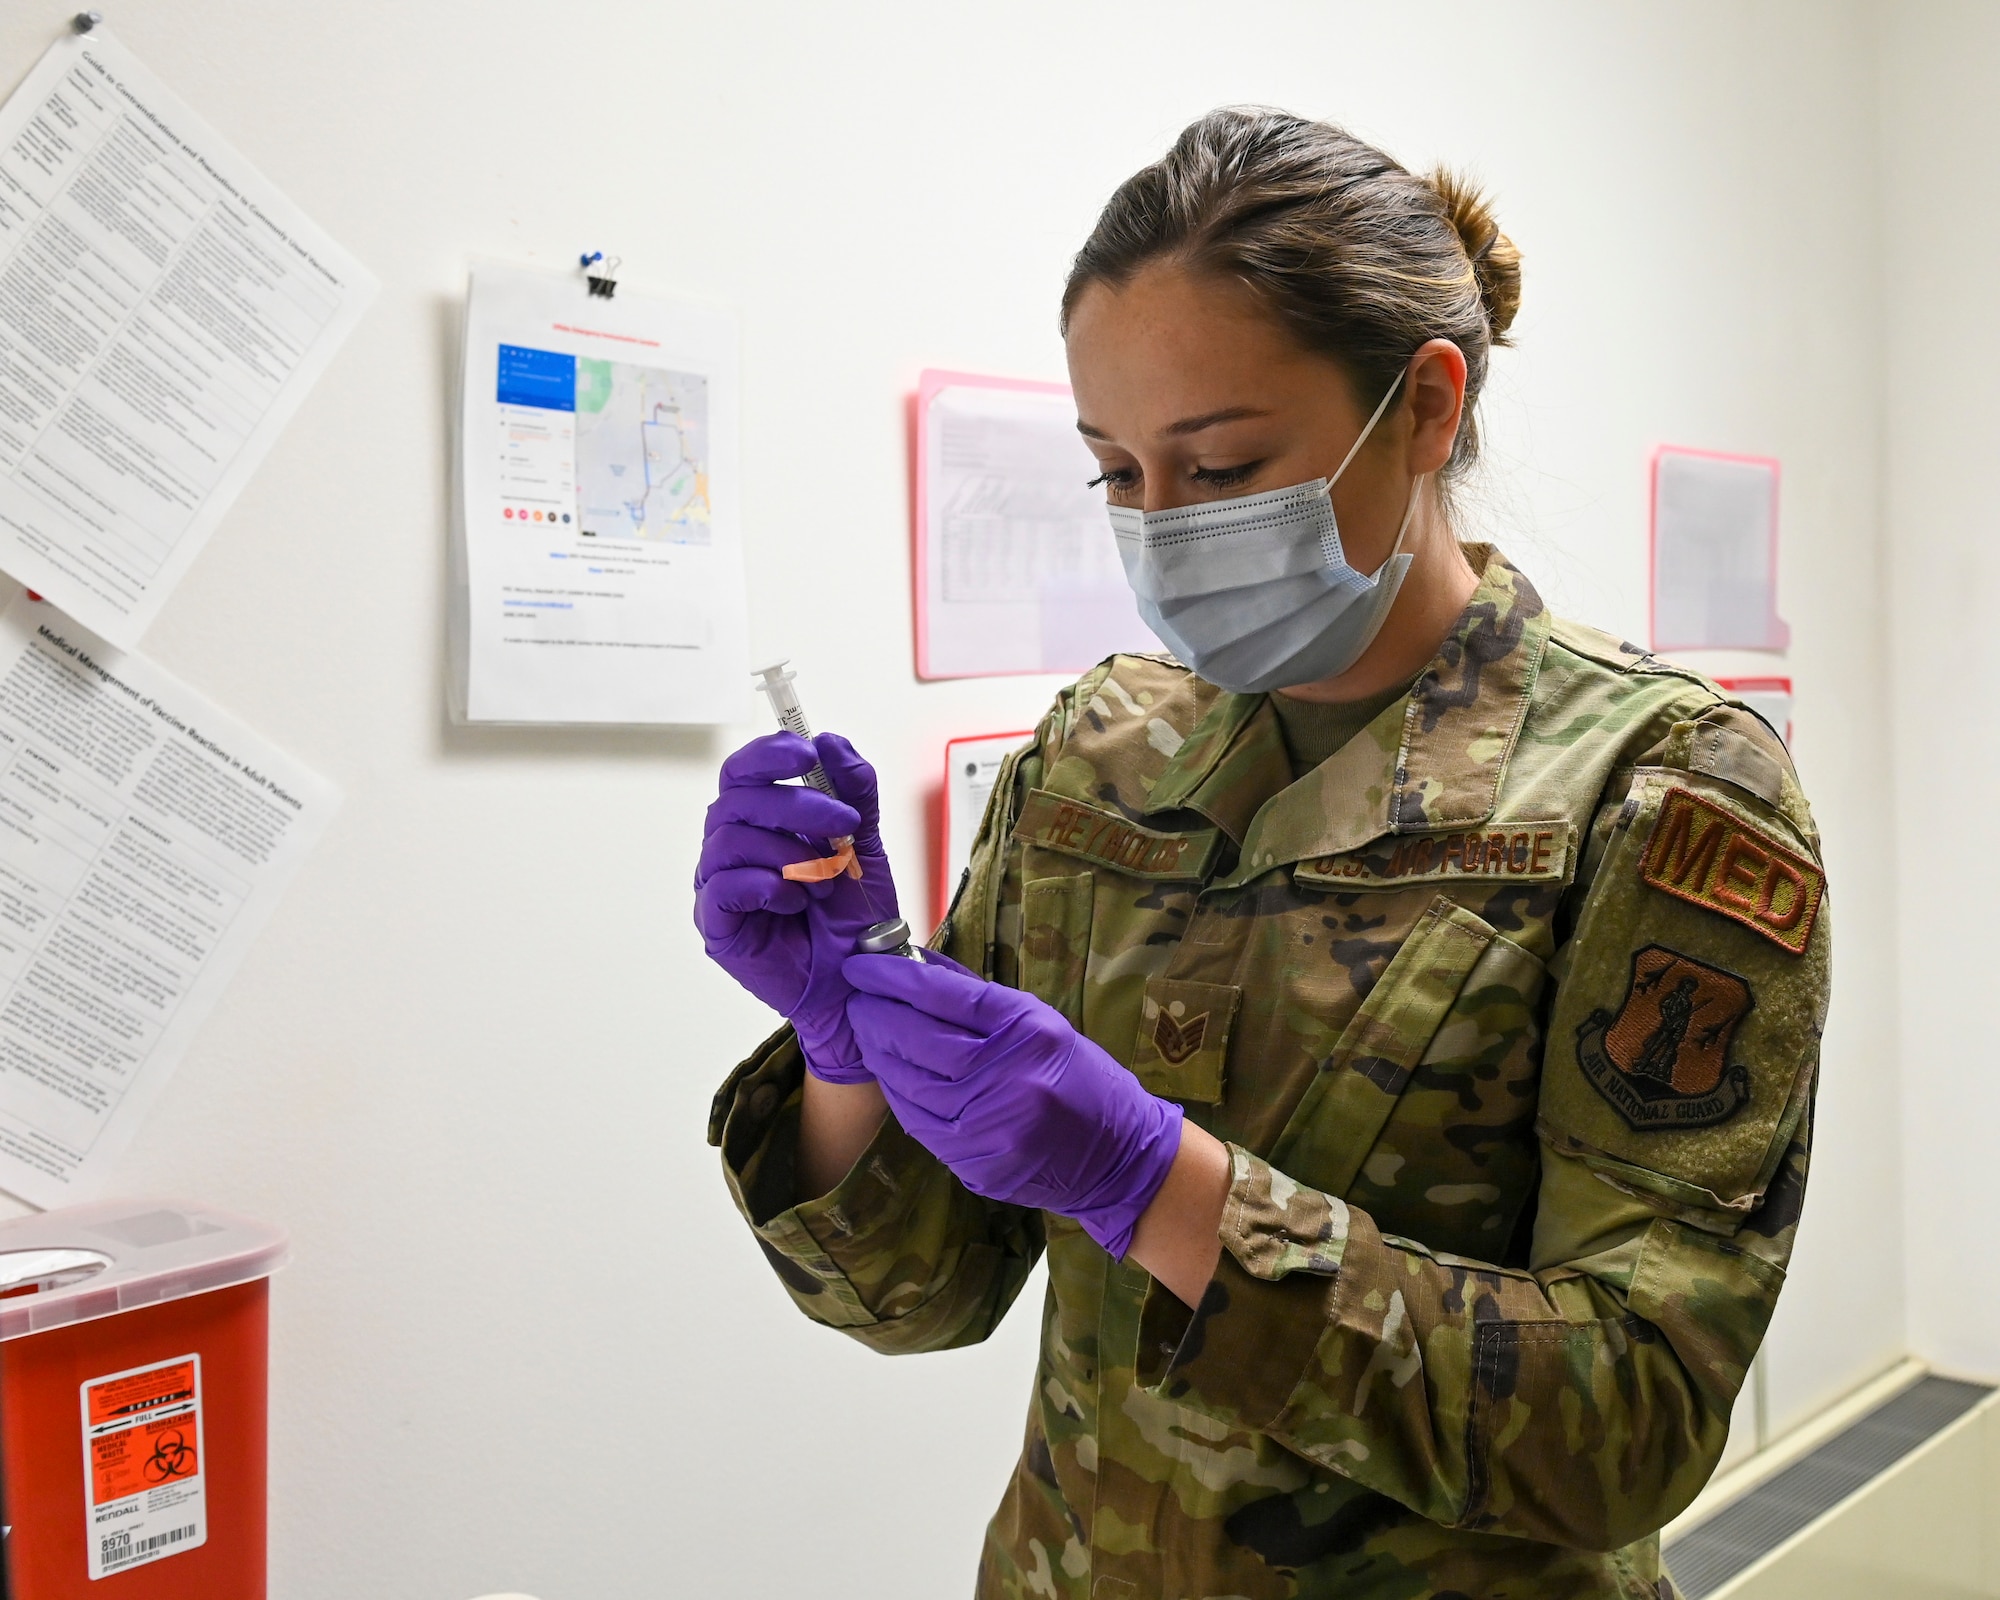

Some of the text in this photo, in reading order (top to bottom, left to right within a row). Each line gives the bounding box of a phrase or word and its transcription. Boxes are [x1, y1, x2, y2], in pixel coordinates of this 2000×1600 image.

[82, 51, 106, 75] Guide
[181, 143, 198, 160] and
[37, 624, 302, 810] Medical Management of Vaccine Reactions in Adult Patients
[1047, 803, 1188, 872] REYNOLDS
[1441, 832, 1553, 873] FORCE
[1653, 804, 1806, 930] MED
[1582, 1051, 1726, 1119] AIR NATIONAL GUARD
[129, 1394, 176, 1411] SHARPS
[135, 1413, 153, 1423] FULL
[146, 1412, 194, 1431] BIOHAZARD
[92, 1430, 132, 1446] REGULATED
[97, 1440, 127, 1454] MEDICAL
[101, 1448, 125, 1461] WASTE
[96, 1504, 140, 1523] KENDALL
[101, 1533, 130, 1551] 8970
